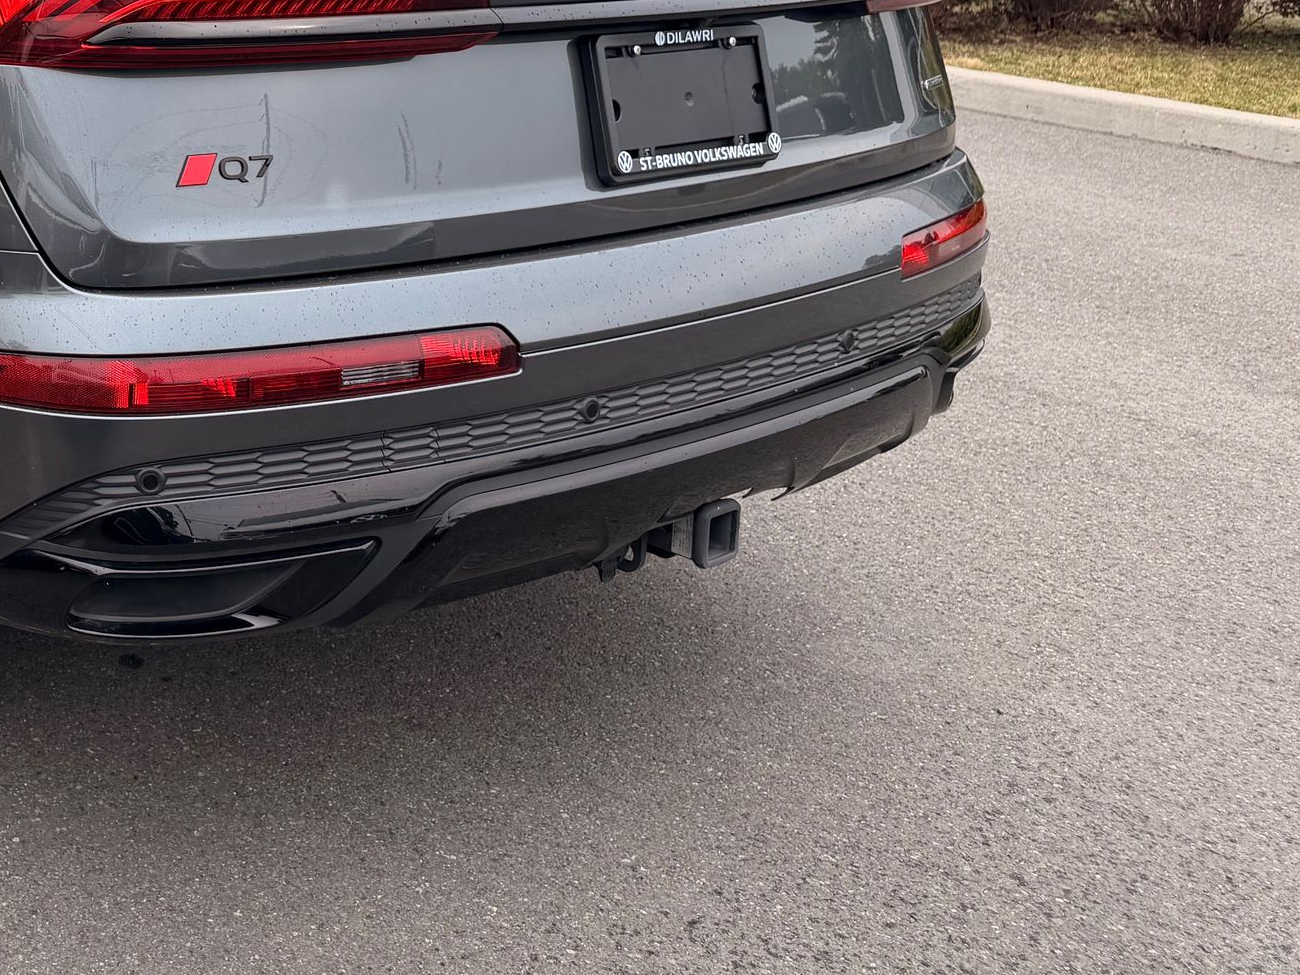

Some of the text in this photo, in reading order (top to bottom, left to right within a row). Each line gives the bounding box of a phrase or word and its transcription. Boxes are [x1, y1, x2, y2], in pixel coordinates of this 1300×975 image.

[666, 29, 714, 45] DILAWRI
[218, 154, 274, 183] Q7
[639, 142, 764, 171] ST-BRUNO VOLKSWAGEN
